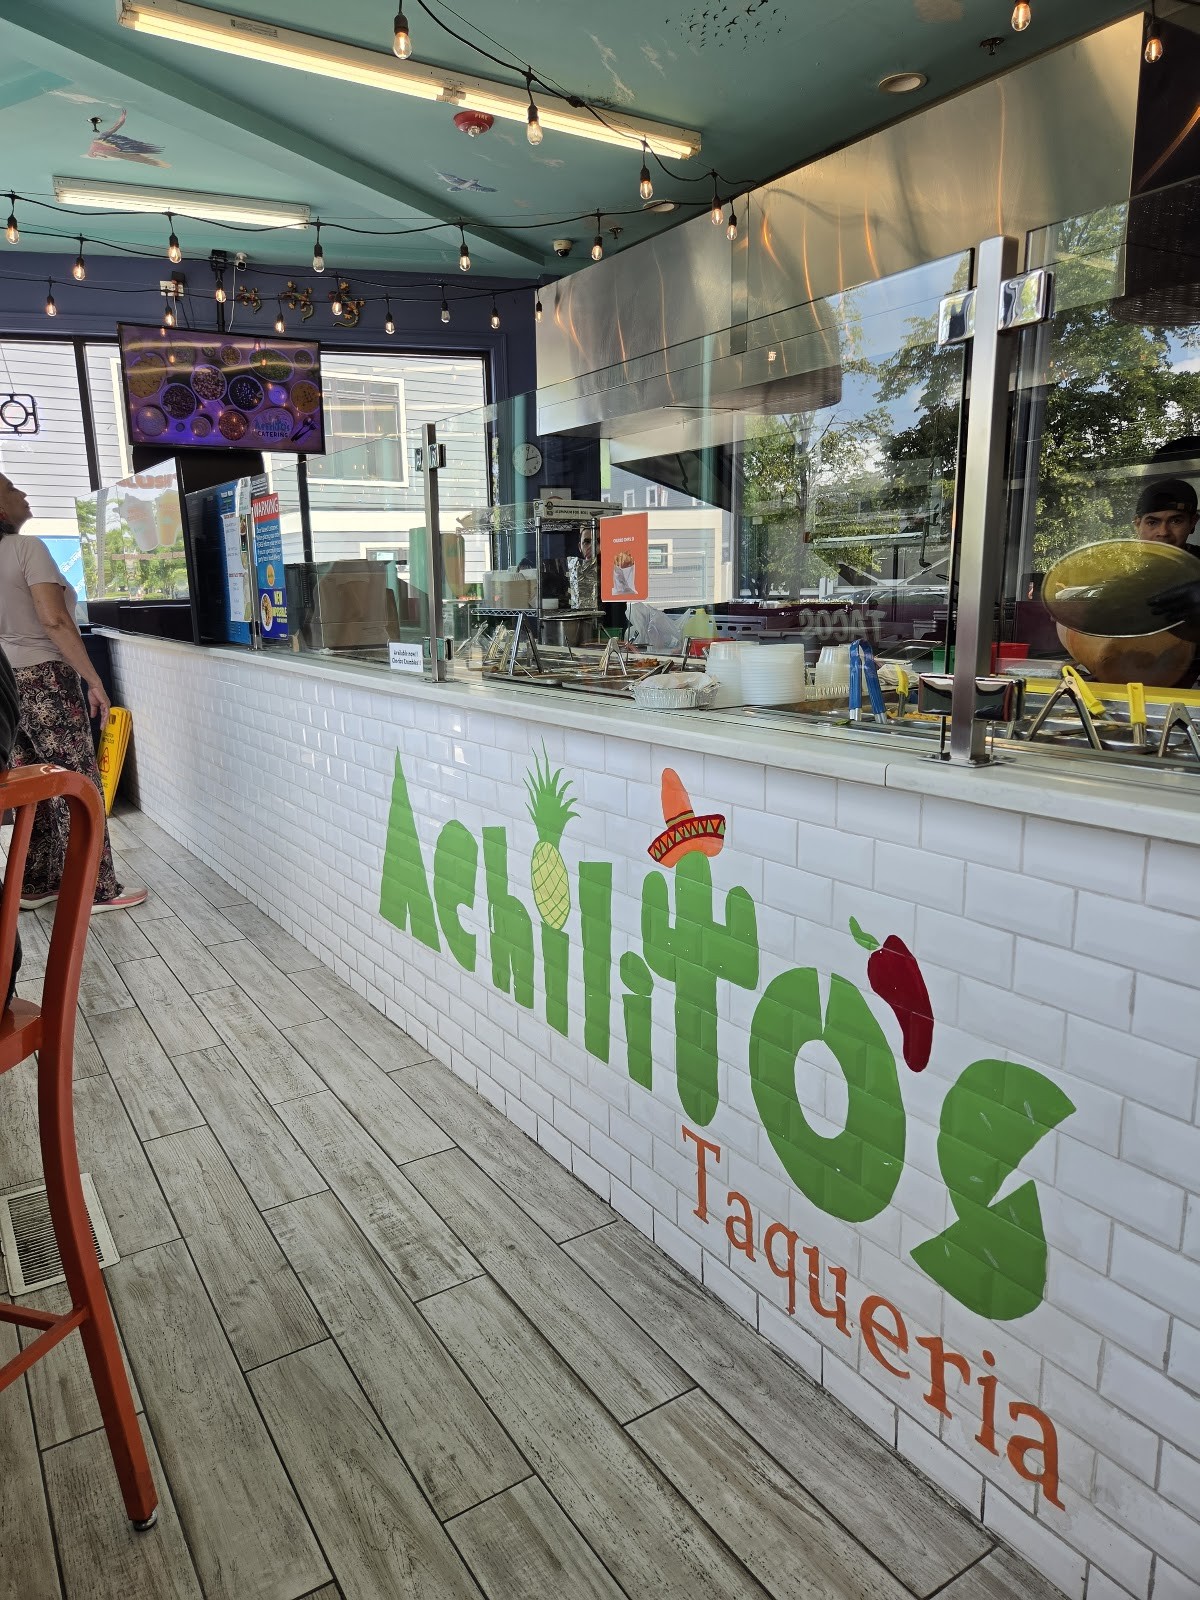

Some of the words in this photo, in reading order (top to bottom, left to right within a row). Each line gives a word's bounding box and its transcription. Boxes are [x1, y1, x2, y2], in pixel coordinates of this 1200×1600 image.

[474, 112, 488, 120] FIRE
[252, 497, 279, 518] WARNING
[681, 1124, 1066, 1511] Taqueria
